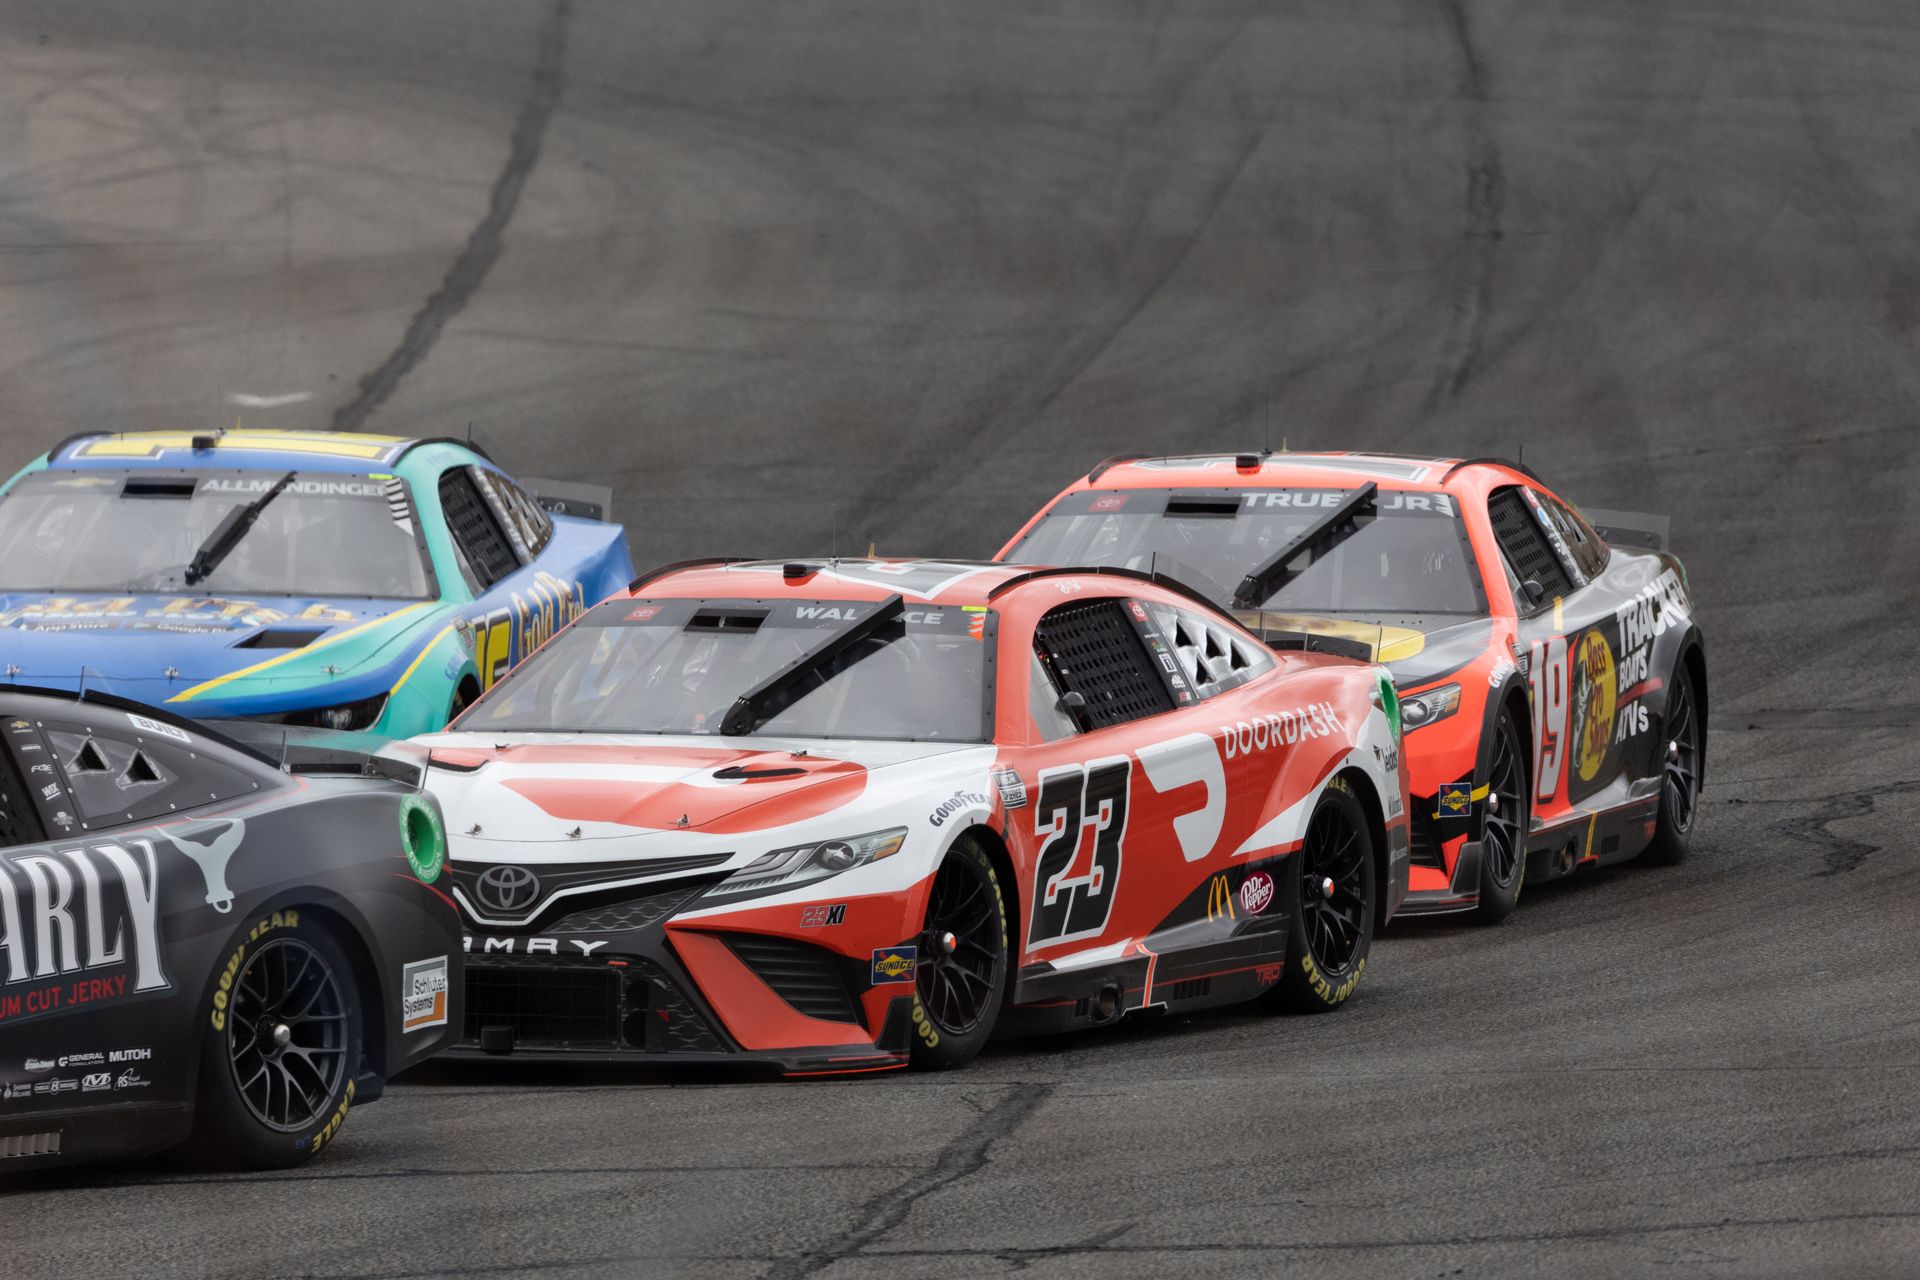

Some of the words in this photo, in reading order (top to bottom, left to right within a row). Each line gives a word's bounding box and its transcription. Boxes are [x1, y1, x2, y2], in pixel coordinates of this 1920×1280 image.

[1242, 492, 1352, 508] TRUE
[1384, 496, 1433, 511] JR
[796, 606, 945, 625] WALCE
[1616, 568, 1692, 657] TRACKER
[1619, 645, 1648, 693] BOATS
[1220, 701, 1346, 760] DOORDASH
[1529, 635, 1568, 804] 19
[1025, 754, 1133, 954] 23
[1240, 880, 1271, 911] Pepper
[1250, 876, 1263, 893] Dr
[462, 935, 609, 957] MRY
[874, 959, 916, 973] SUNOCO
[27, 986, 61, 1013] CUT
[67, 975, 127, 1006] JERKY
[404, 996, 434, 1018] Systems
[68, 1052, 105, 1062] GENERAL
[109, 1048, 151, 1062] MUTOH
